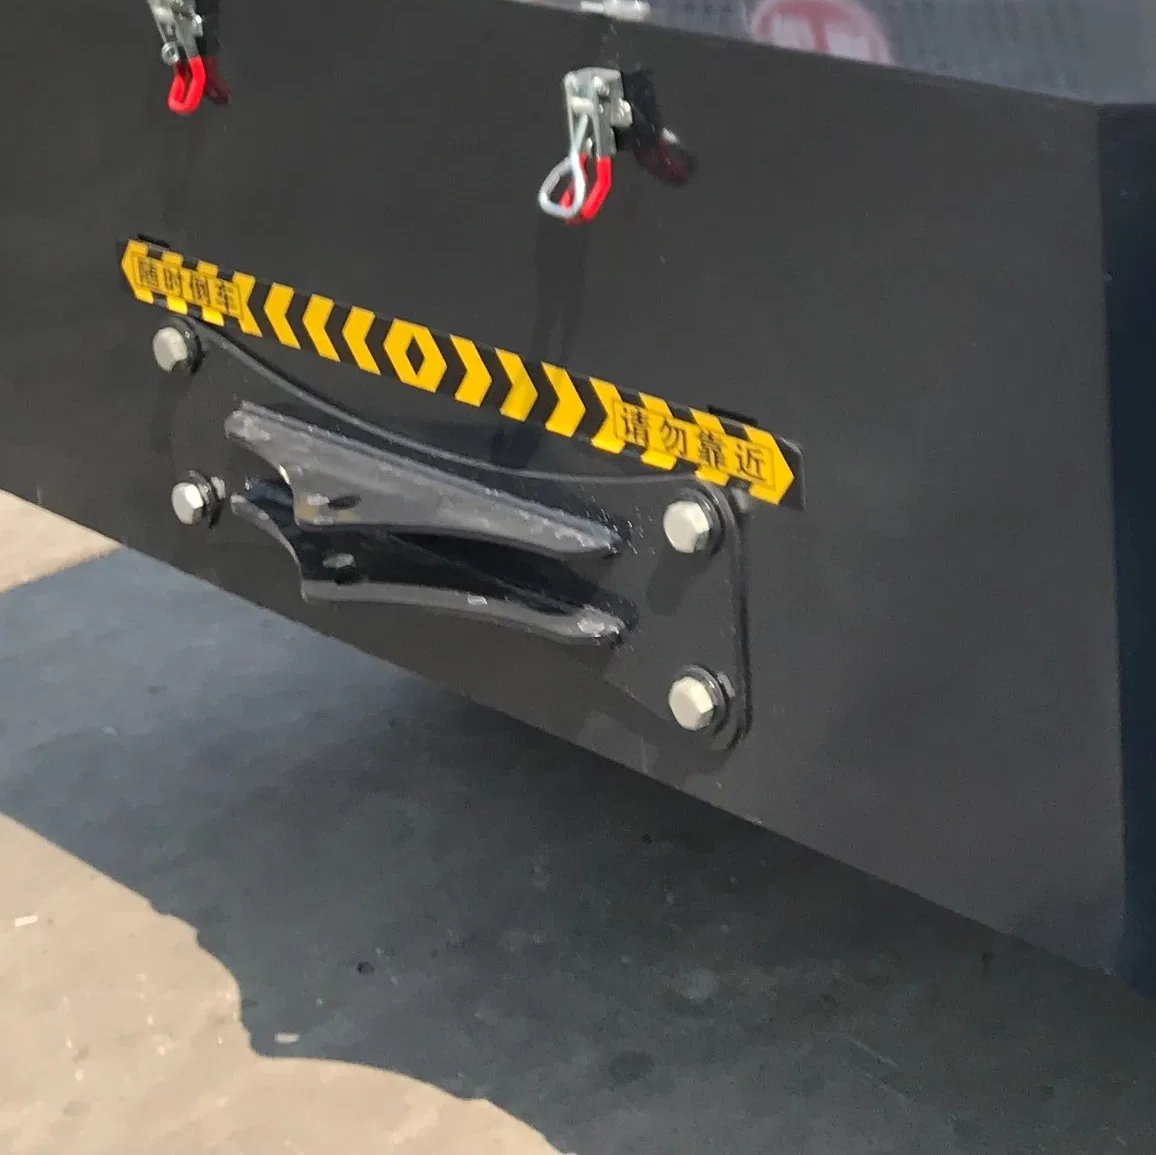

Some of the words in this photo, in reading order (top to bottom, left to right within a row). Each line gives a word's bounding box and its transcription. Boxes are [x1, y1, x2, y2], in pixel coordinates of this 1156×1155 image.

[138, 255, 239, 319] 随时倒车
[621, 407, 768, 481] 请勿靠近
